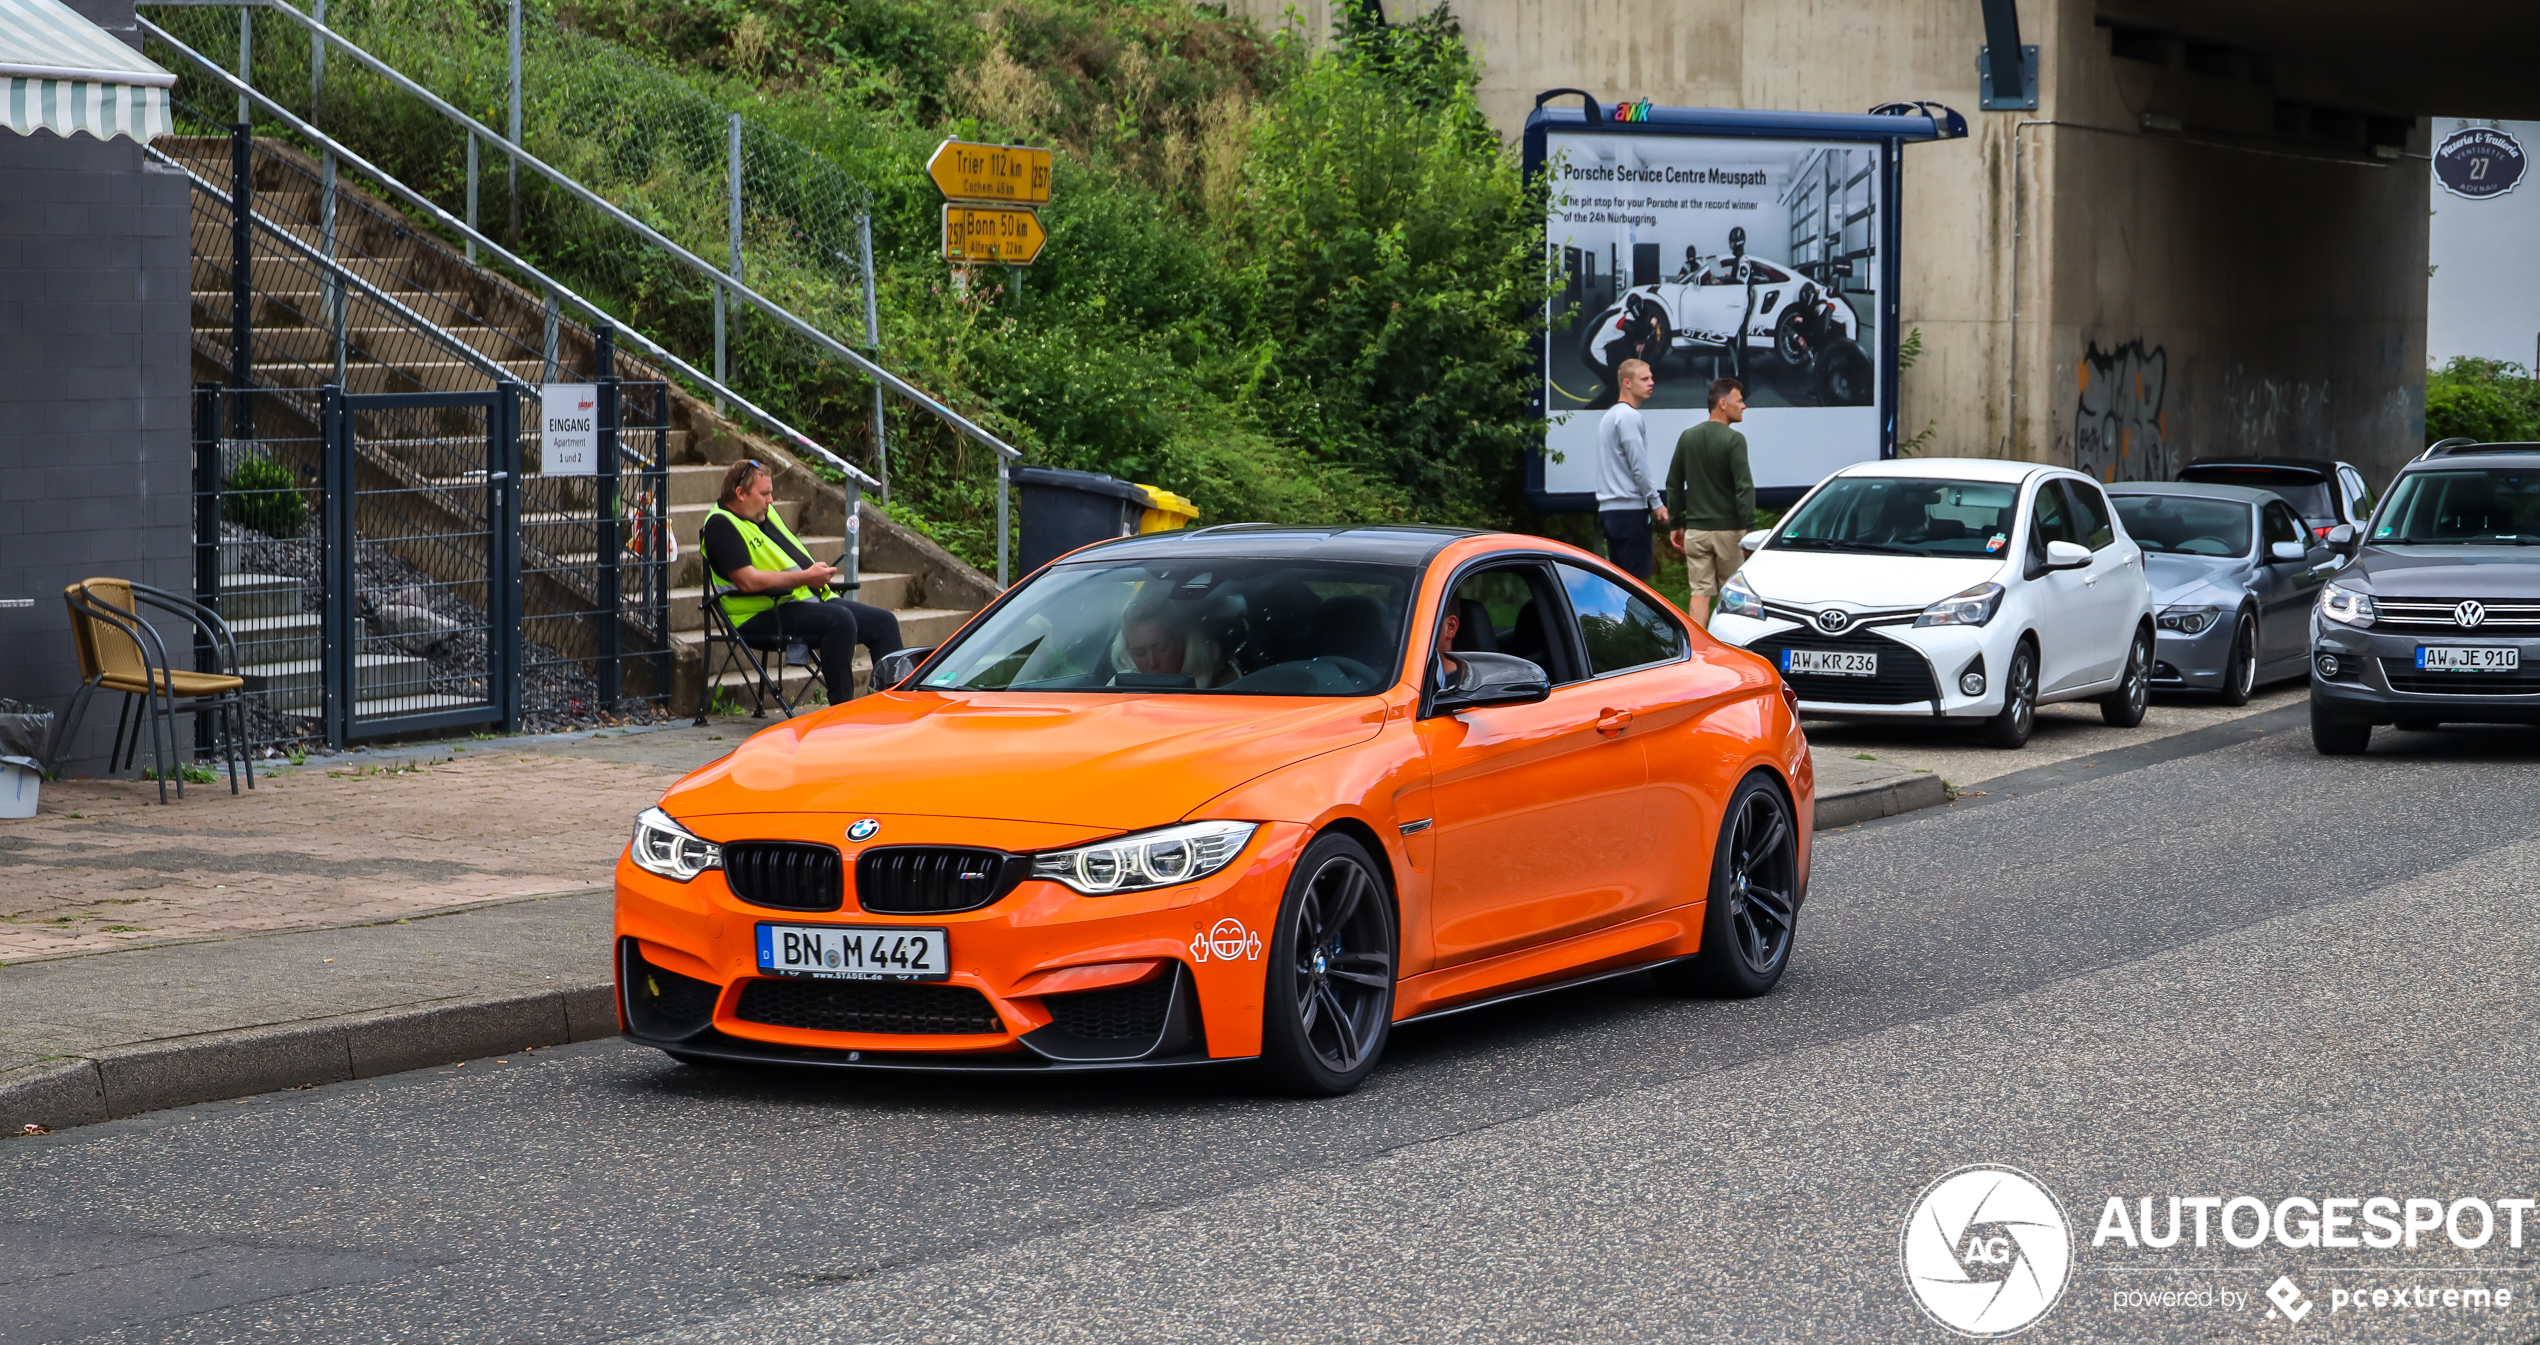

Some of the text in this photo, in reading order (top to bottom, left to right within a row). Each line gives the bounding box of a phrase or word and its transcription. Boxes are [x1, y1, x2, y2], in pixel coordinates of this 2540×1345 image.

[1614, 97, 1653, 123] awk
[2440, 132, 2520, 158] Pizzeria & Trattoria
[957, 150, 1023, 178] Trier 112 km
[2469, 158, 2490, 180] 27
[1033, 166, 1049, 188] 257
[1564, 164, 1767, 188] Porsche Service Centre Meuspath
[964, 178, 994, 194] Cochem
[1006, 182, 1015, 195] km
[2459, 183, 2498, 193] ADENAU
[1581, 196, 1592, 210] pit
[1594, 197, 1612, 210] stop
[1614, 197, 1625, 208] for
[1627, 199, 1645, 211] your
[1646, 197, 1679, 209] Porsche
[1680, 198, 1689, 209] at
[1690, 198, 1703, 210] the
[1704, 198, 1730, 210] record
[1732, 199, 1759, 210] winner
[967, 212, 1028, 237] Bonn 50 km
[1564, 212, 1659, 226] of the 24h Nürburgring.
[948, 222, 964, 245] 257
[1005, 241, 1013, 255] 22
[1014, 242, 1023, 255] km
[549, 418, 590, 432] EINGANG
[553, 438, 586, 449] Apartment
[560, 452, 582, 463] 1 und 2
[1791, 652, 1812, 668] AW
[1822, 653, 1842, 669] KR
[1846, 655, 1874, 671] 236
[2426, 649, 2448, 666] AW
[2459, 650, 2481, 666] JE
[2484, 650, 2516, 666] 910
[763, 932, 930, 970] D BN M 442
[812, 972, 883, 981] www.STADEL.de
